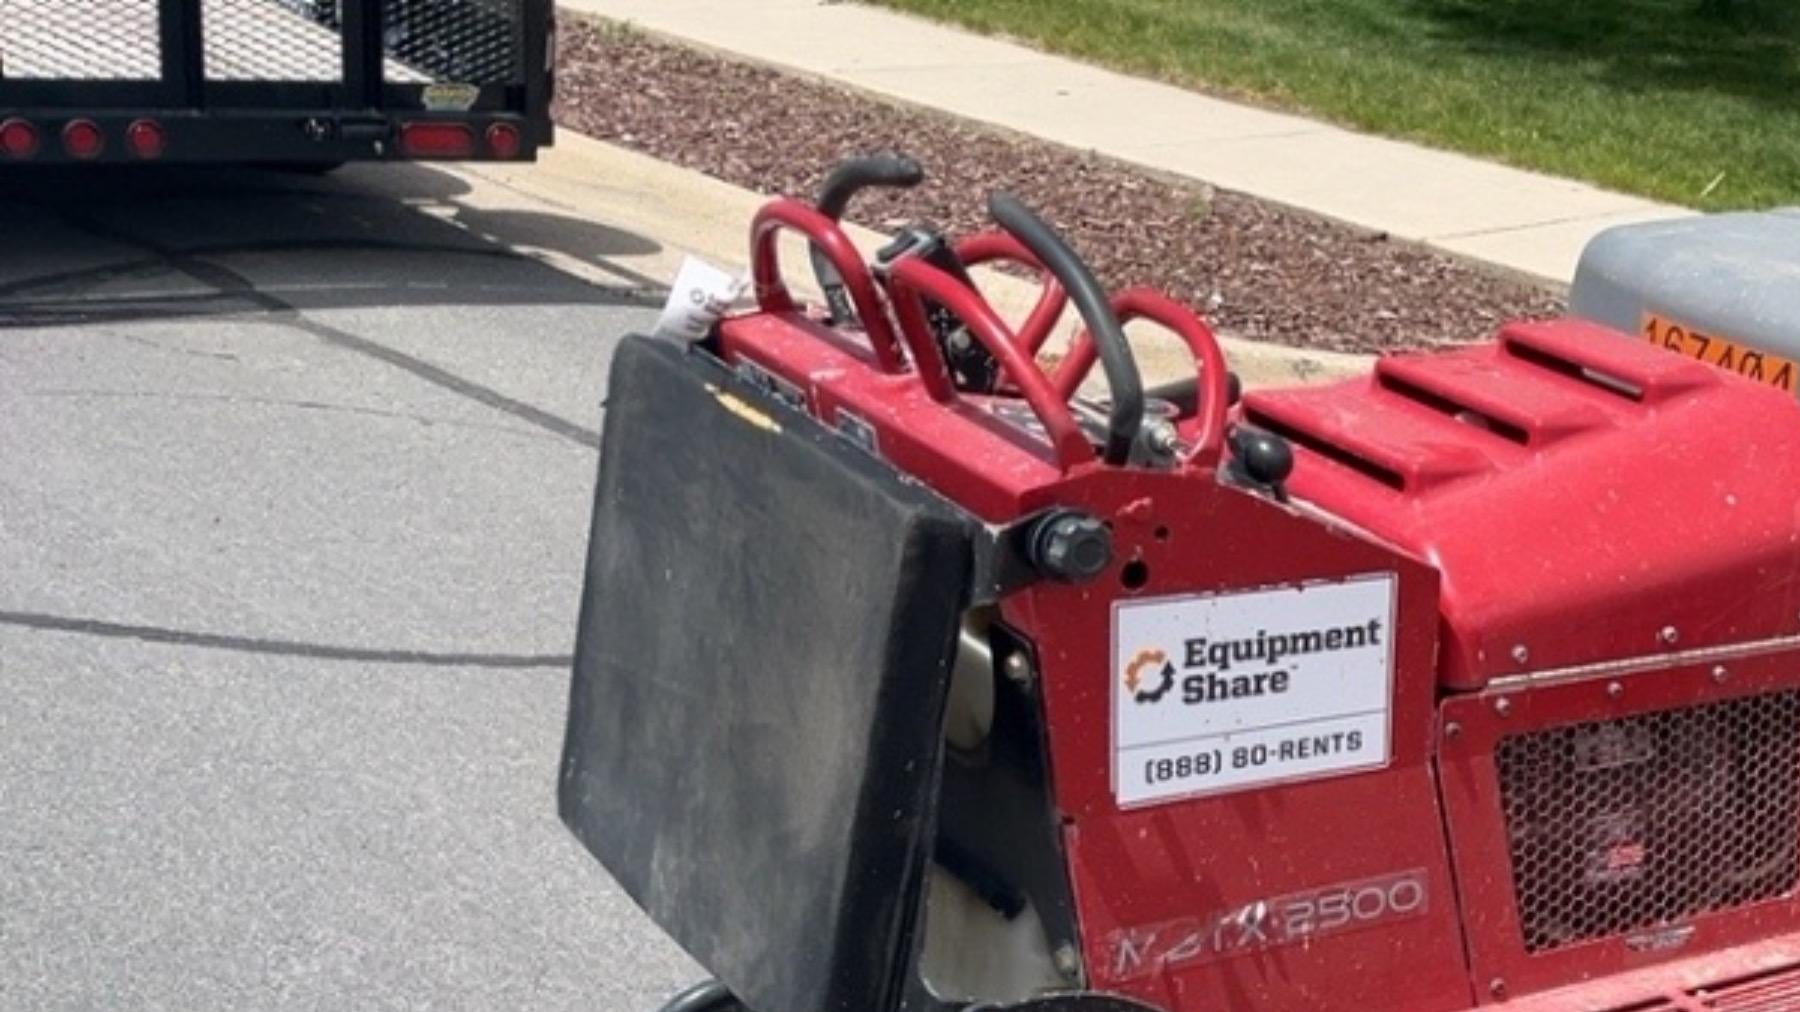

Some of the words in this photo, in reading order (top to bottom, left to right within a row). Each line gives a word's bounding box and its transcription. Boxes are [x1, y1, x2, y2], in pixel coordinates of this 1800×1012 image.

[1182, 618, 1382, 671] Equipment
[1144, 749, 1223, 784] (888)
[1231, 731, 1363, 769] 80-RENTS
